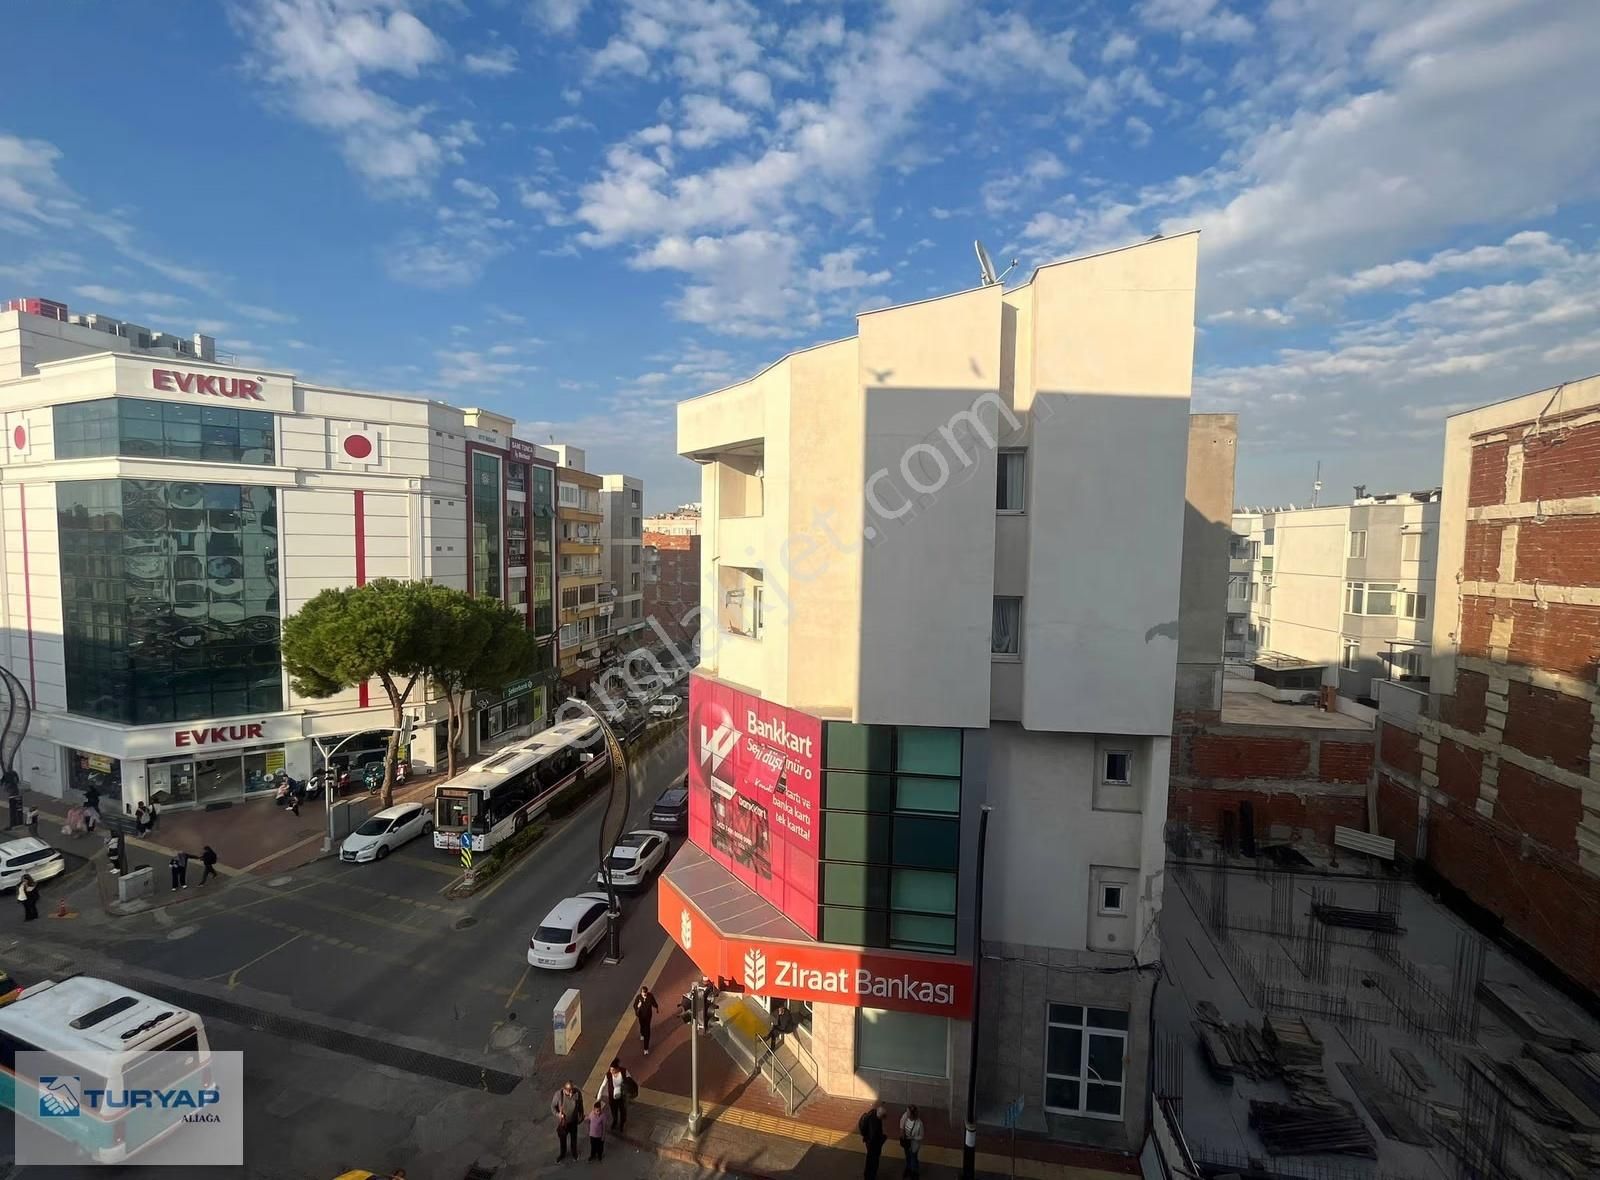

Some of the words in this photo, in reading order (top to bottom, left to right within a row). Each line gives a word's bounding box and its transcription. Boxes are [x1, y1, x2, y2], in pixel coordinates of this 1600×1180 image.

[152, 368, 265, 401] EVKUR
[175, 724, 264, 747] EVKUR
[747, 710, 812, 758] Bankkart
[773, 794, 794, 816] banka
[794, 805, 810, 826] kartı
[776, 812, 786, 826] tek
[801, 798, 811, 809] ve
[775, 960, 848, 994] Ziraat
[855, 969, 955, 1005] Bankası
